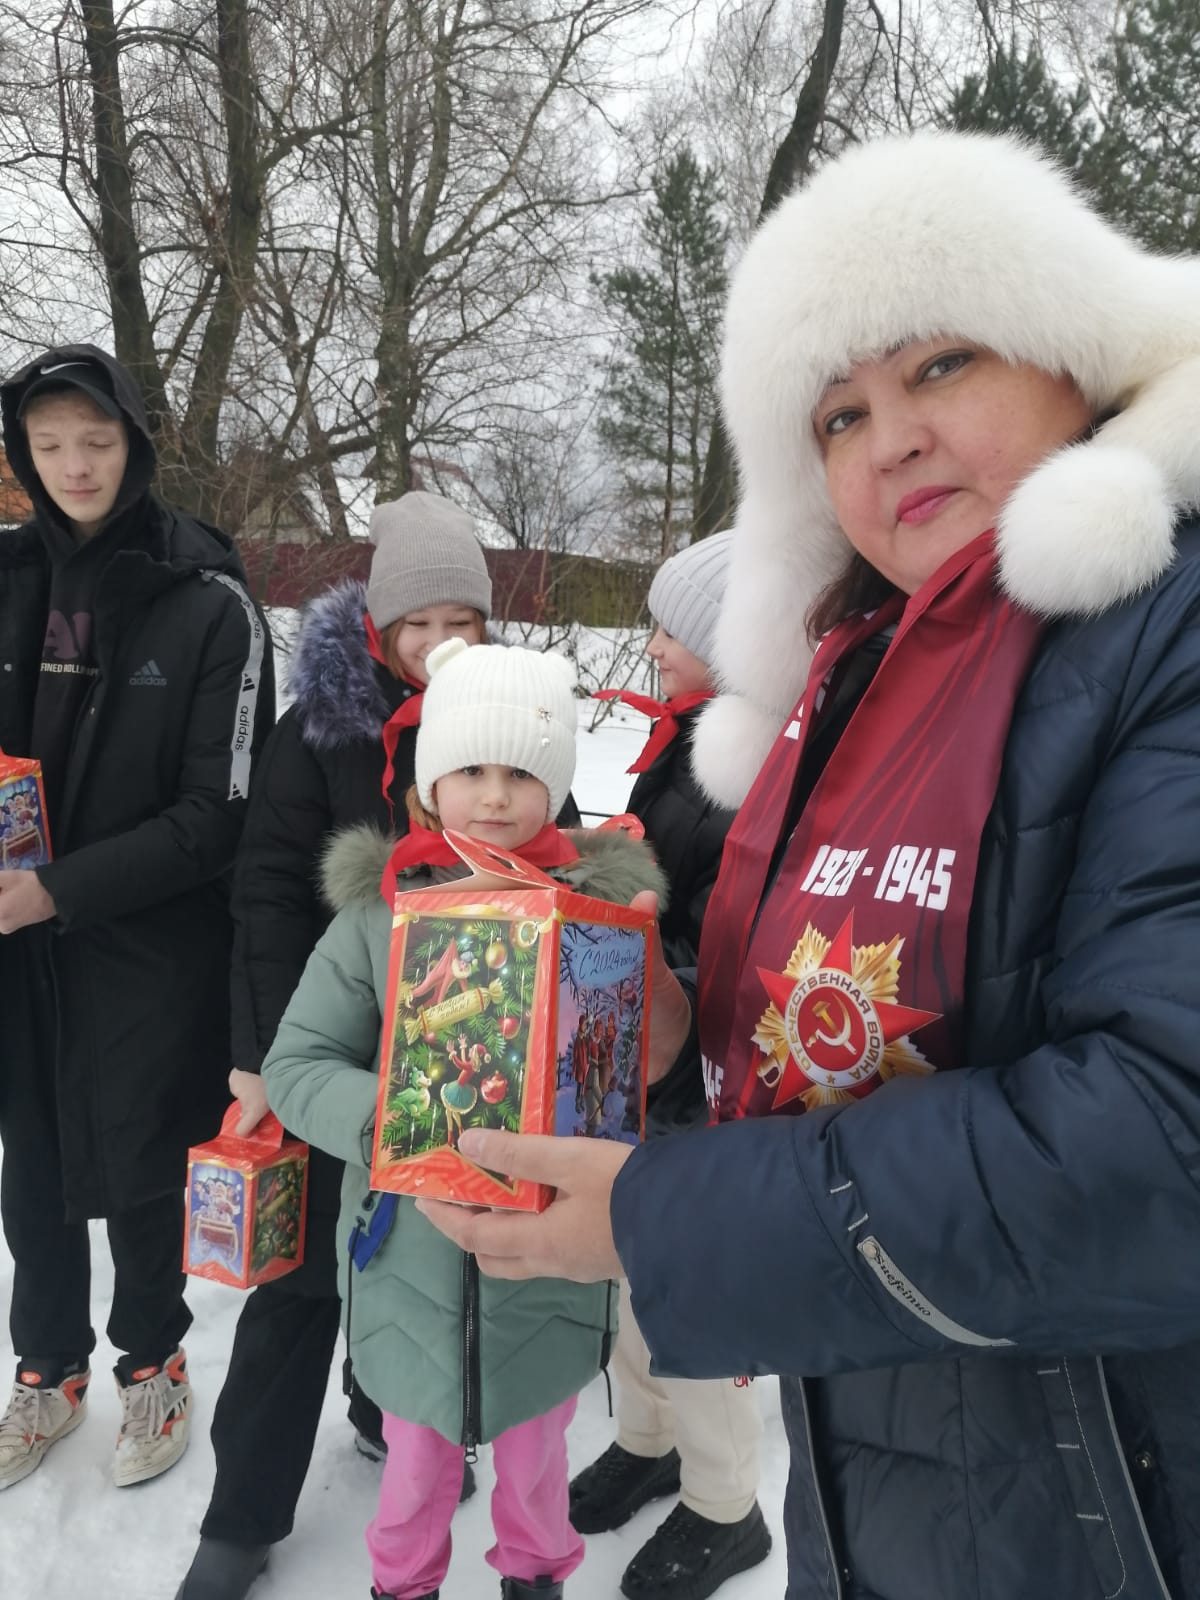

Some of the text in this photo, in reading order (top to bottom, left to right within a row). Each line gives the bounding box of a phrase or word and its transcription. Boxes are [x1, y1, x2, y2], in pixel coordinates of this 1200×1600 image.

[129, 677, 168, 687] adidas
[235, 705, 250, 751] adidas
[873, 844, 956, 912] 1945
[788, 972, 872, 1072] ОТЕЧЕСТВЕННАЯ
